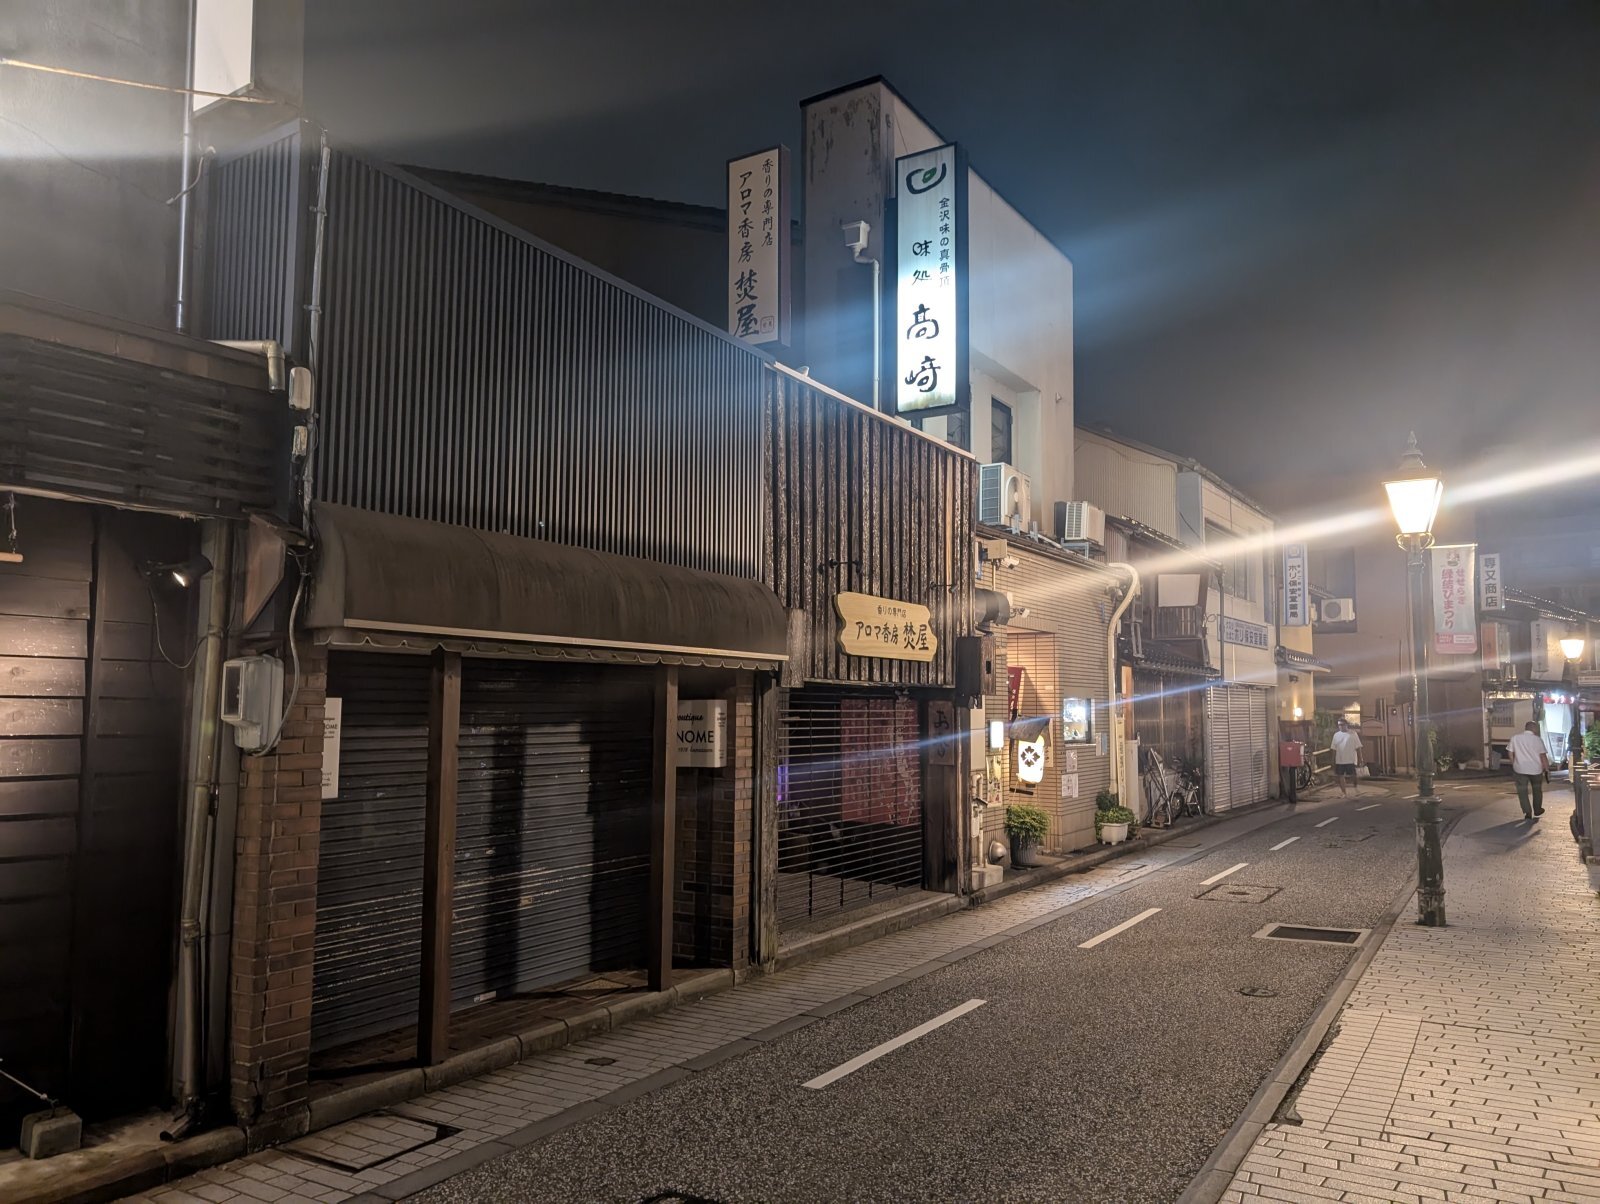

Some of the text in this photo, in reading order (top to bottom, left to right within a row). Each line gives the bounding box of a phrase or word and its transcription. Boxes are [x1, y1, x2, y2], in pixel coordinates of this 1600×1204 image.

[761, 158, 774, 247] 香りの専門店
[877, 605, 906, 618] 香りの専門店
[1442, 568, 1455, 629] 縁結びまつり
